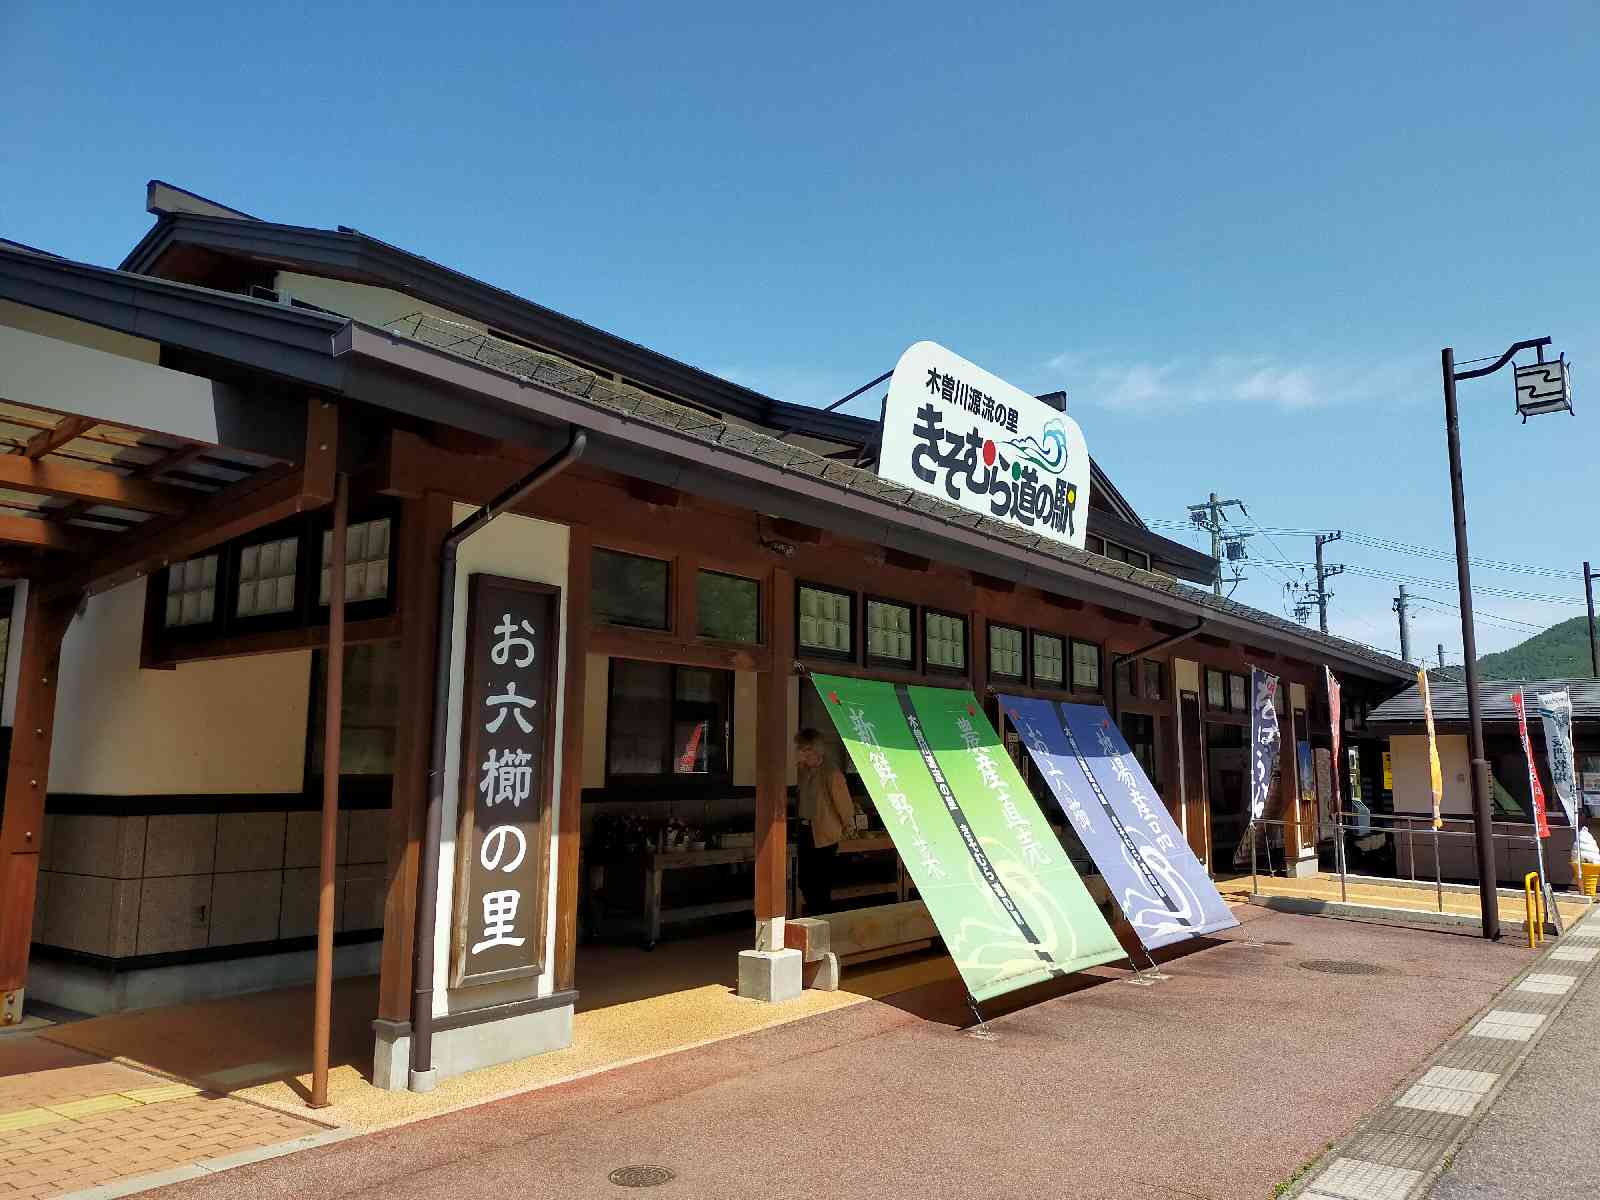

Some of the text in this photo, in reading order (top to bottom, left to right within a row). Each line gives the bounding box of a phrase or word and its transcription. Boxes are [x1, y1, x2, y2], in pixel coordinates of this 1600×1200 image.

[925, 367, 1019, 434] 木曽川源流の里
[911, 402, 1078, 539] きそむら道の駅
[471, 612, 537, 956] お六櫛の里
[849, 705, 950, 881] 新鮮野菜
[1096, 727, 1176, 851] 地場産品
